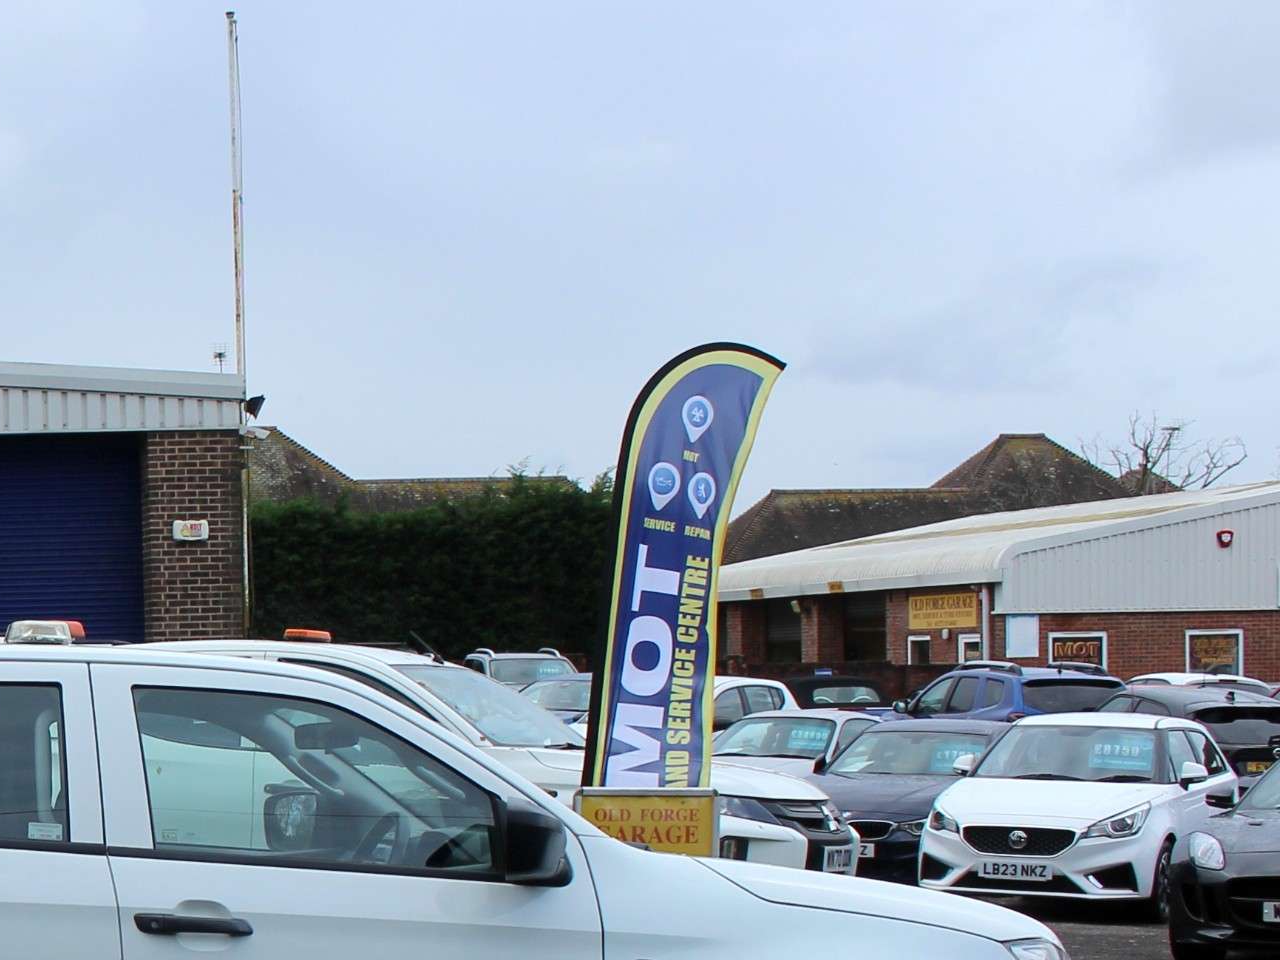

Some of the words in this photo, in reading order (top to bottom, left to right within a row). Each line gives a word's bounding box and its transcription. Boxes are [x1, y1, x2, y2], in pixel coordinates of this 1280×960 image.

[676, 554, 710, 644] CENTRE
[604, 543, 681, 788] MOT
[665, 647, 696, 745] SERVICE
[594, 808, 632, 822] OLD
[640, 808, 700, 822] FORGE
[983, 862, 1018, 877] LB23
[1021, 864, 1047, 878] NKZ
